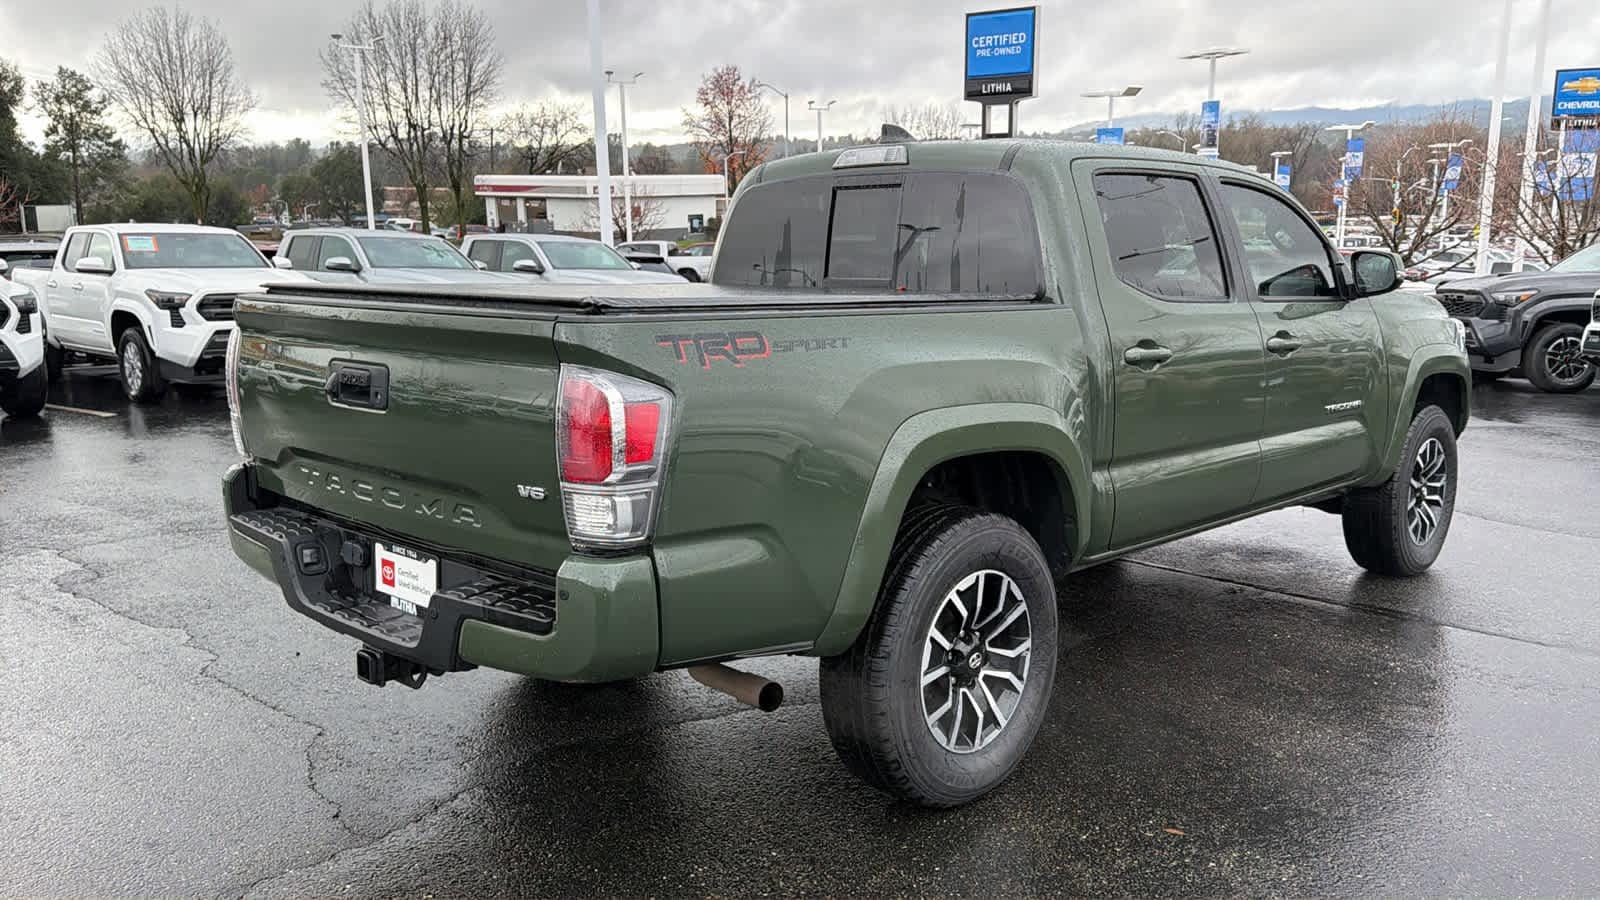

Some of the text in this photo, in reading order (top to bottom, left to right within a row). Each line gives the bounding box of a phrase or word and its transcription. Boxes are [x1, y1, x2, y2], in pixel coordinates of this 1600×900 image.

[972, 32, 1026, 48] CERTIFIED
[976, 45, 1022, 57] PRE-OWNED
[982, 82, 1012, 94] LITHIA
[655, 330, 852, 370] TRD SPORT
[299, 465, 482, 528] TACOMA
[516, 484, 545, 500] V6
